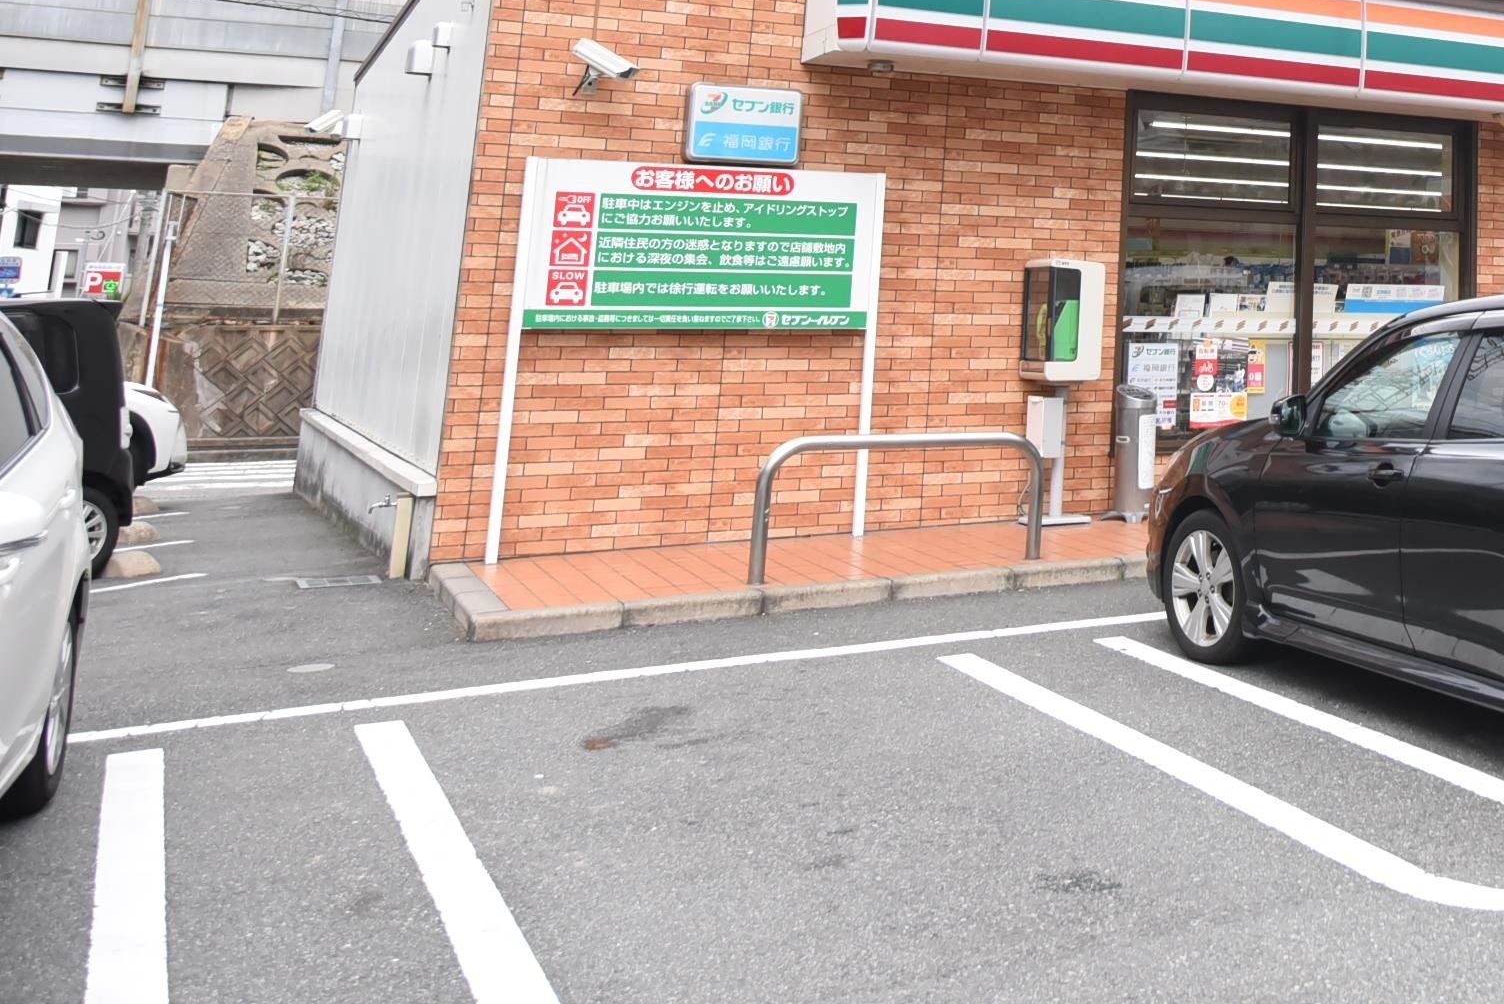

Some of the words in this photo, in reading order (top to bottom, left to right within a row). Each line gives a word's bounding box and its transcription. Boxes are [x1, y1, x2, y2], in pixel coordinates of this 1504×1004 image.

[732, 98, 795, 115] セブン銀行
[723, 133, 792, 152] 福岡銀行
[635, 169, 792, 194] お客様へのお願い
[577, 195, 592, 204] OFF
[601, 197, 849, 218] 駐車中はエンジンを止め、アイドリングストップ
[601, 213, 753, 229] にご協力お願いいたします。
[598, 236, 846, 255] 近隣住民の方の迷惑となりますので店舗敷地内
[85, 272, 103, 293] P
[552, 271, 585, 281] SLOW
[594, 282, 827, 297] 駐車場内では徐行運転をお願いいたします。
